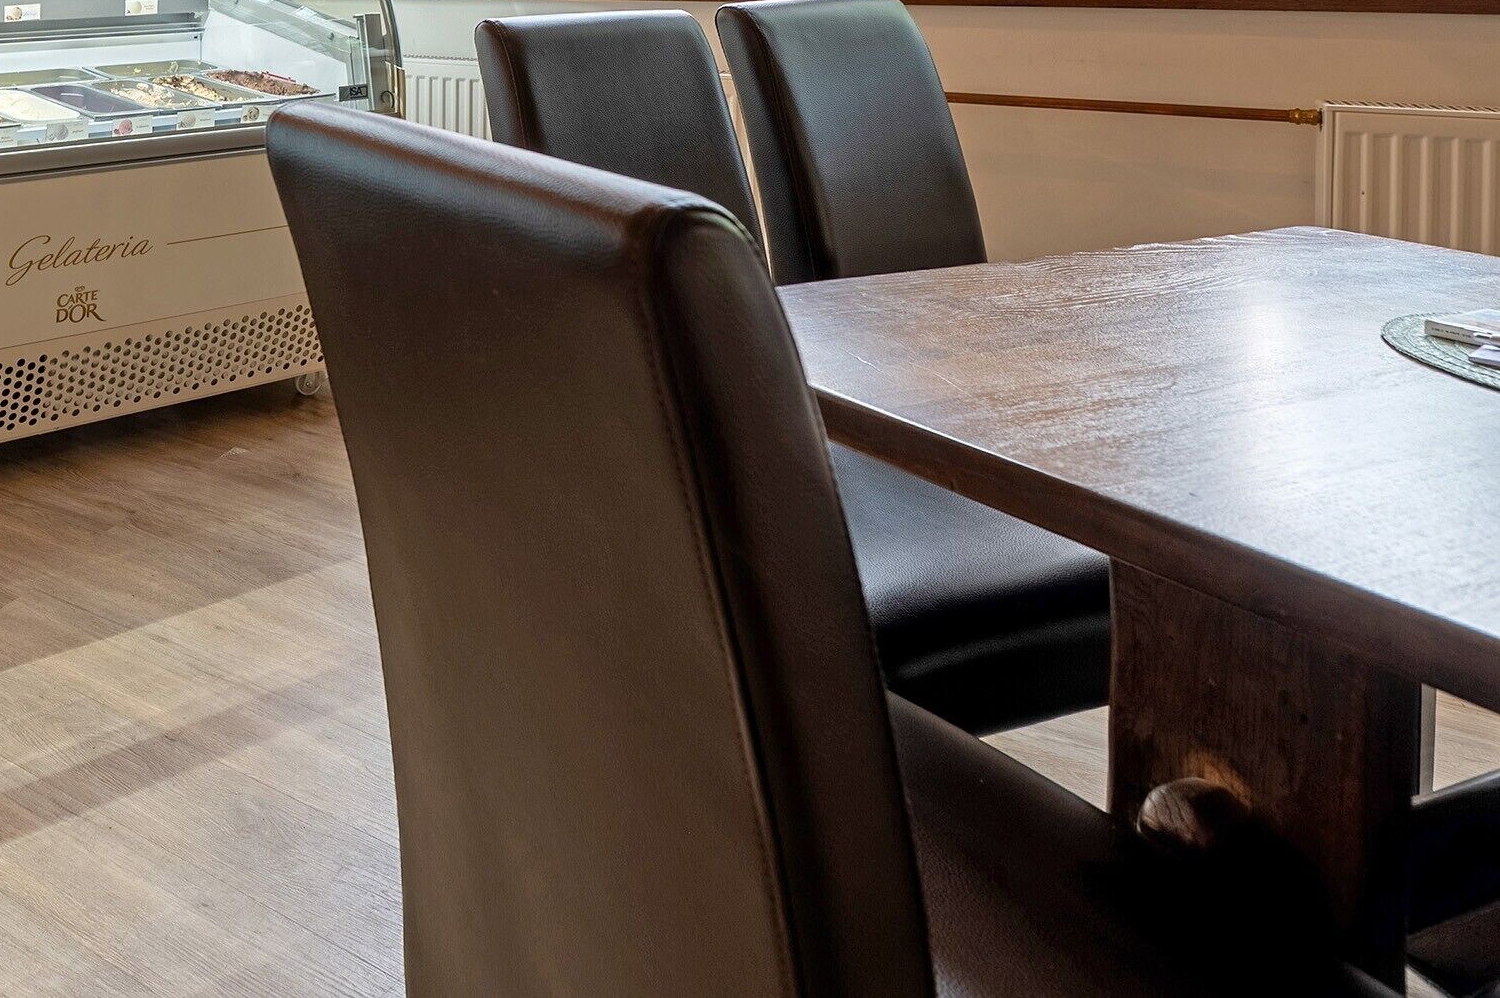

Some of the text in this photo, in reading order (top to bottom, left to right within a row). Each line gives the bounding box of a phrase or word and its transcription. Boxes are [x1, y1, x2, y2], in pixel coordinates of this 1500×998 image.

[5, 235, 153, 286] Gelateria
[56, 289, 100, 308] CARTE
[55, 303, 107, 323] D'OR
